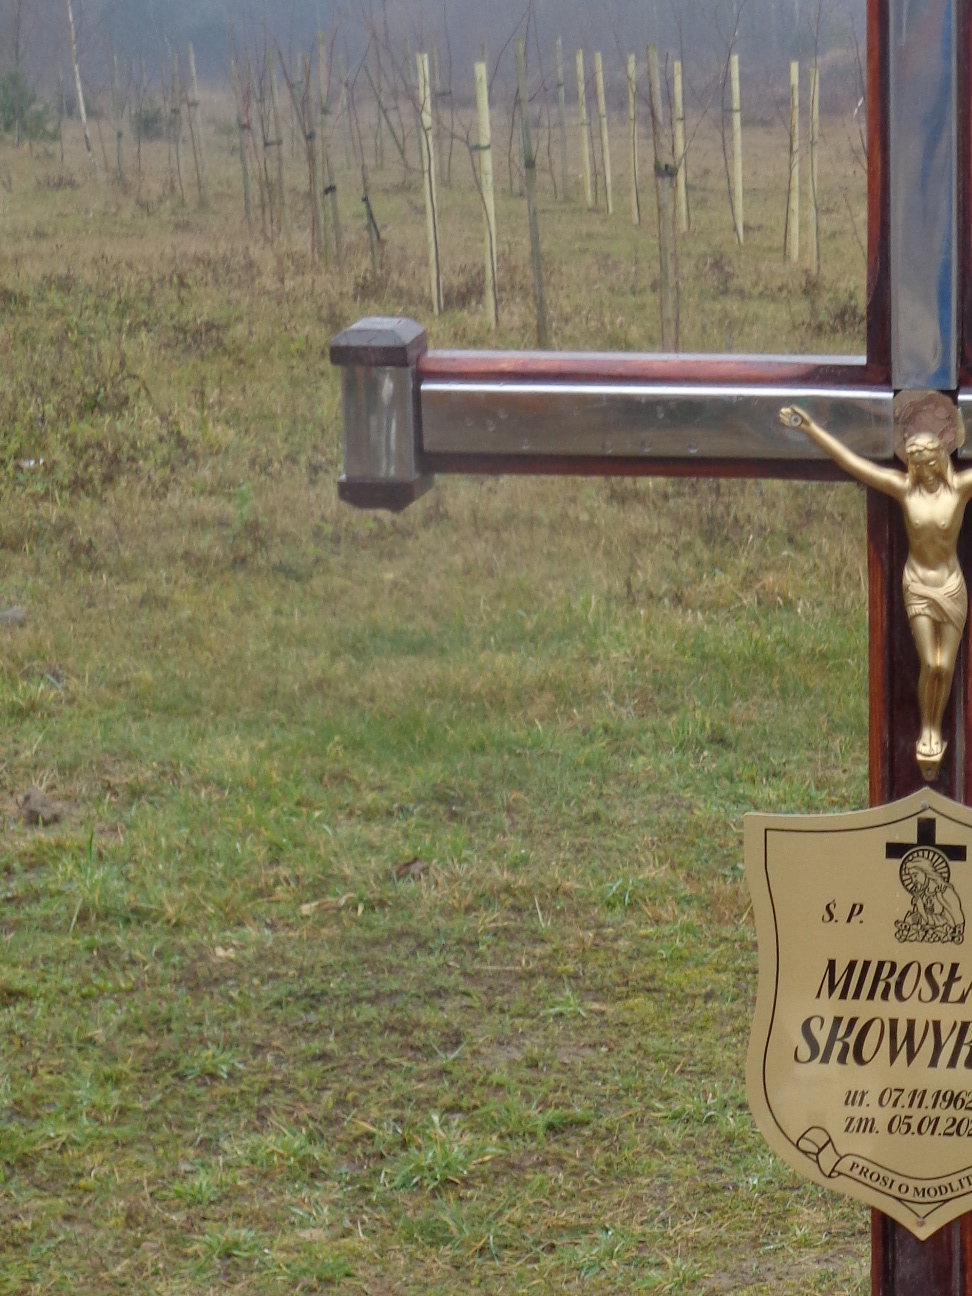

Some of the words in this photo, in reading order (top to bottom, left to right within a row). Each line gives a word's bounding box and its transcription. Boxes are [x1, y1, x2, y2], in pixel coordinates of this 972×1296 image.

[845, 902, 864, 925] P.
[843, 1089, 870, 1108] ur.
[843, 1115, 880, 1135] zm.
[849, 1161, 895, 1190] PROSI
[898, 1182, 910, 1195] O
